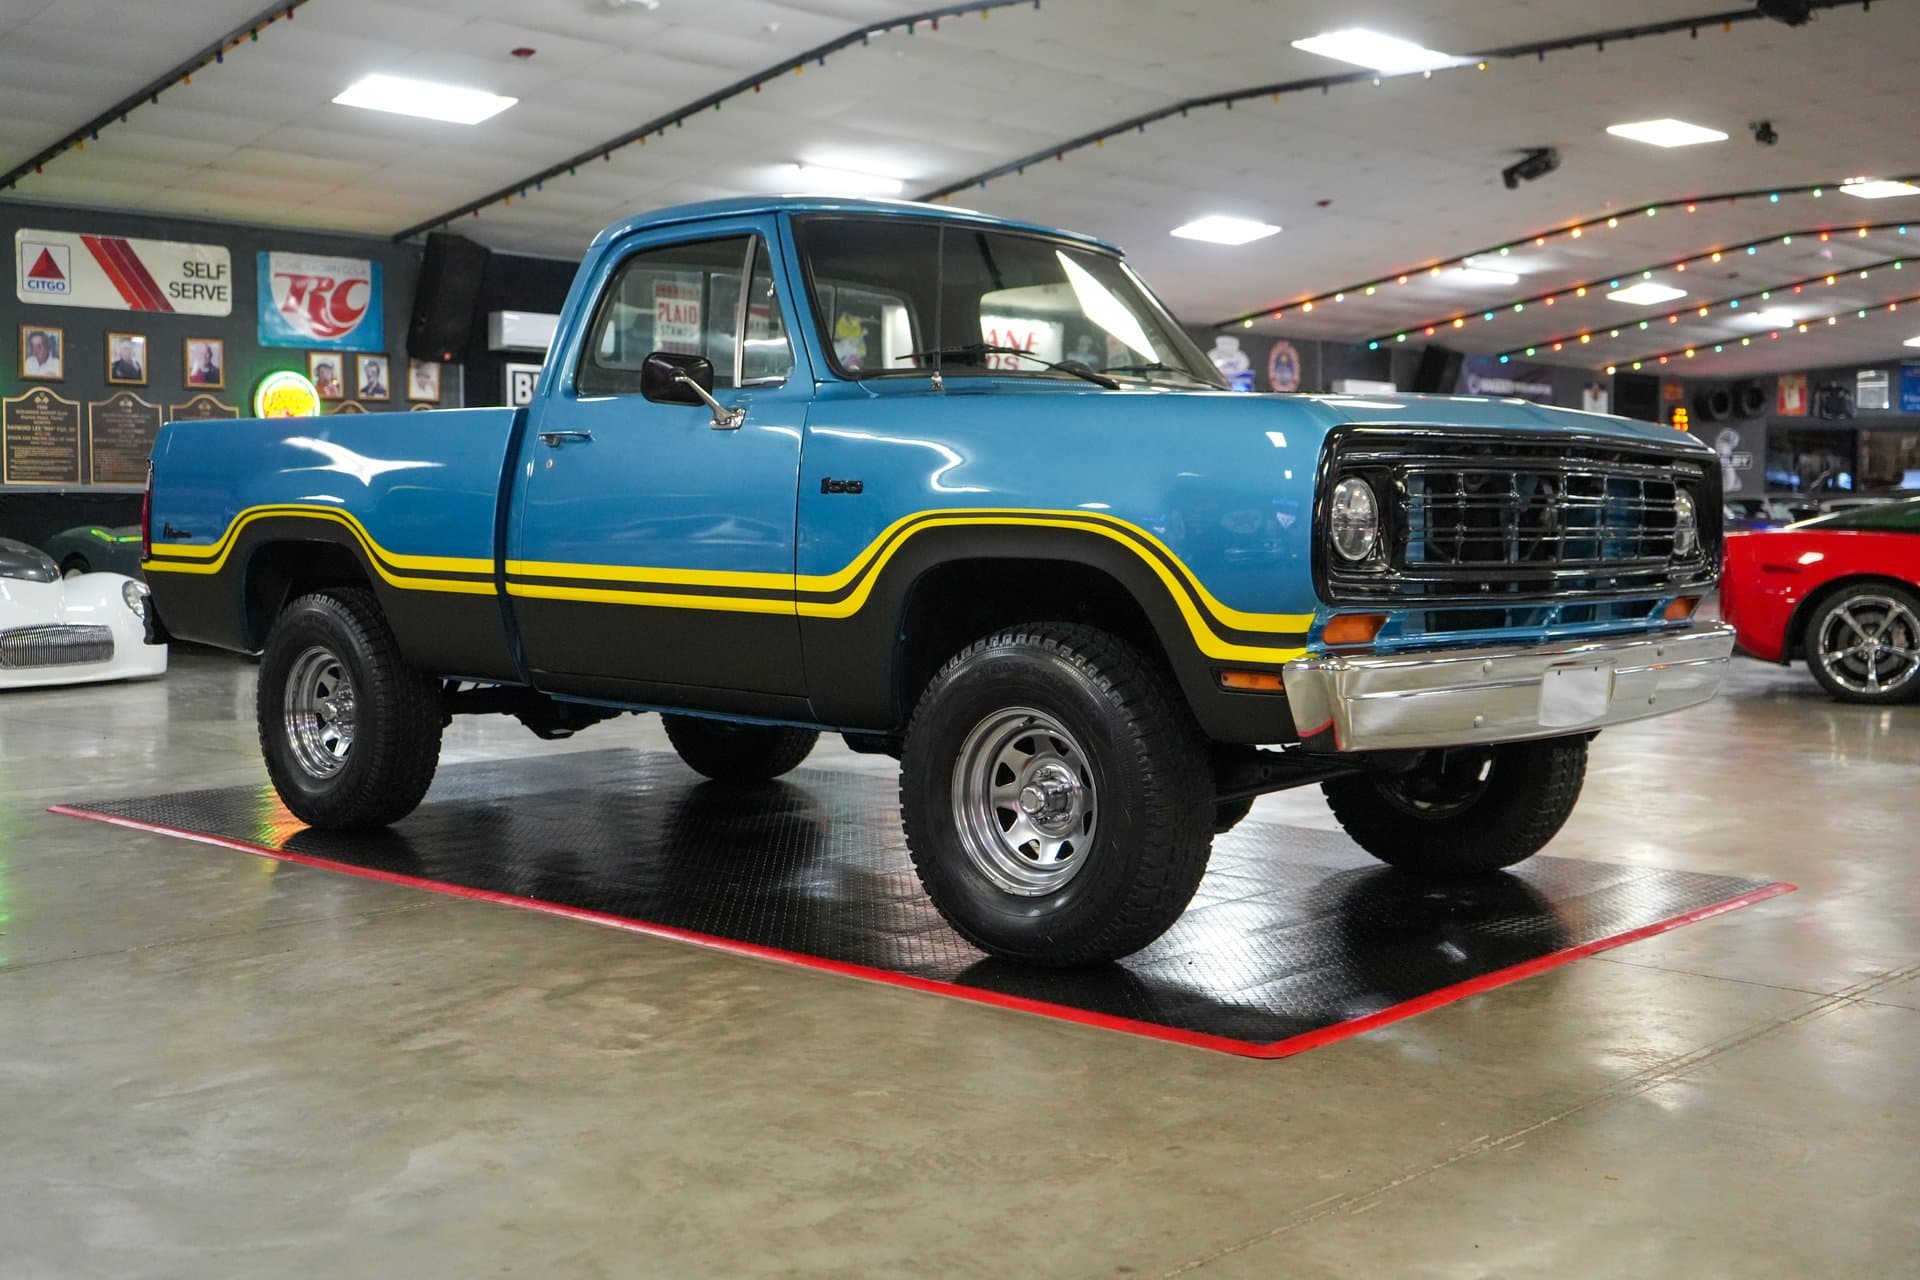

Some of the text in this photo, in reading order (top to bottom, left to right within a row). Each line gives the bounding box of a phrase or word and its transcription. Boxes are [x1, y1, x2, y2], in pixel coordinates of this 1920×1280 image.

[183, 261, 227, 280] SELF
[28, 280, 65, 291] CITGO
[169, 282, 228, 301] SERVE
[274, 272, 369, 337] RC
